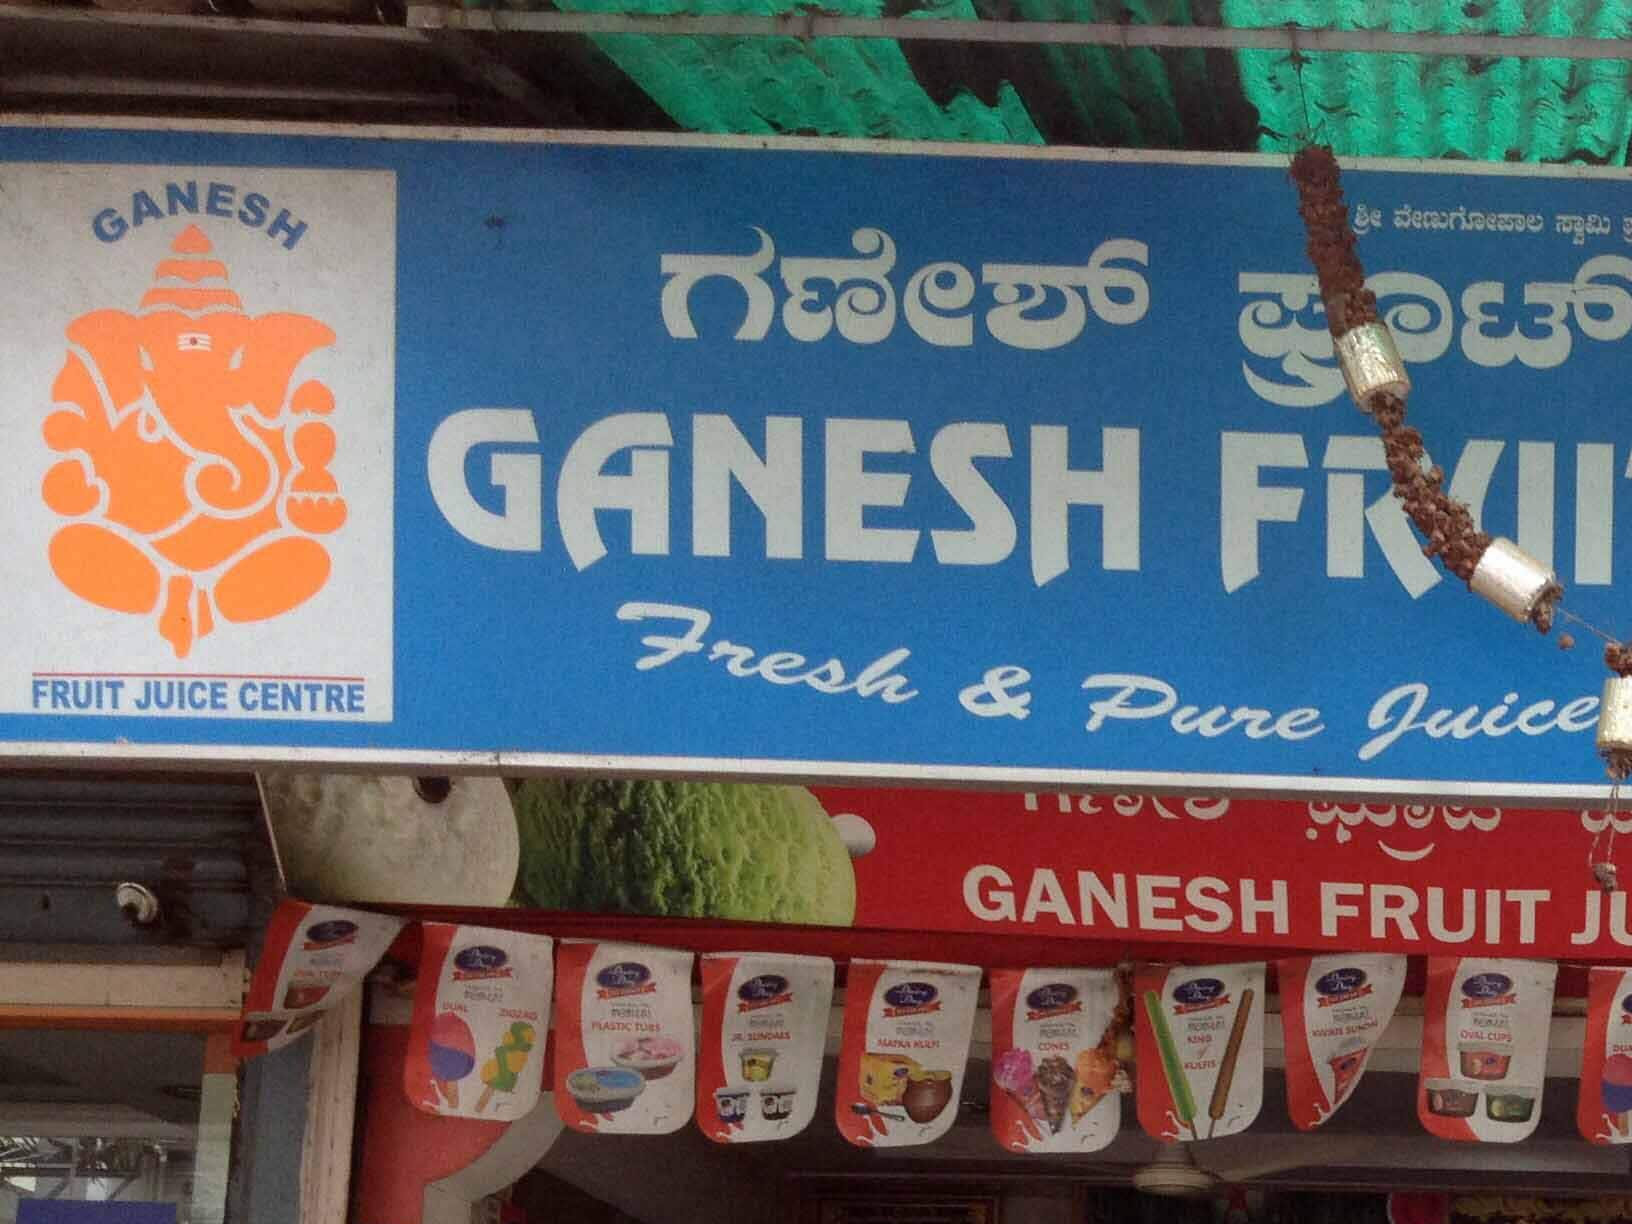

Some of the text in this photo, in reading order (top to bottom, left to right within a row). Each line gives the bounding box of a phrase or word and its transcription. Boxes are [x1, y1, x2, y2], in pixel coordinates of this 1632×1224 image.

[91, 180, 308, 252] GANESH
[661, 226, 1149, 351] ಗಣೇಶ್
[427, 409, 1141, 588] GANESH
[33, 679, 366, 714] FRUIT JUICE CENTRE
[616, 602, 919, 705] Fresh
[958, 665, 1034, 722] &
[1083, 672, 1326, 741] Pure
[1358, 683, 1598, 761] Juice
[963, 864, 1289, 935] GANESH
[1320, 881, 1551, 946] FRUIT
